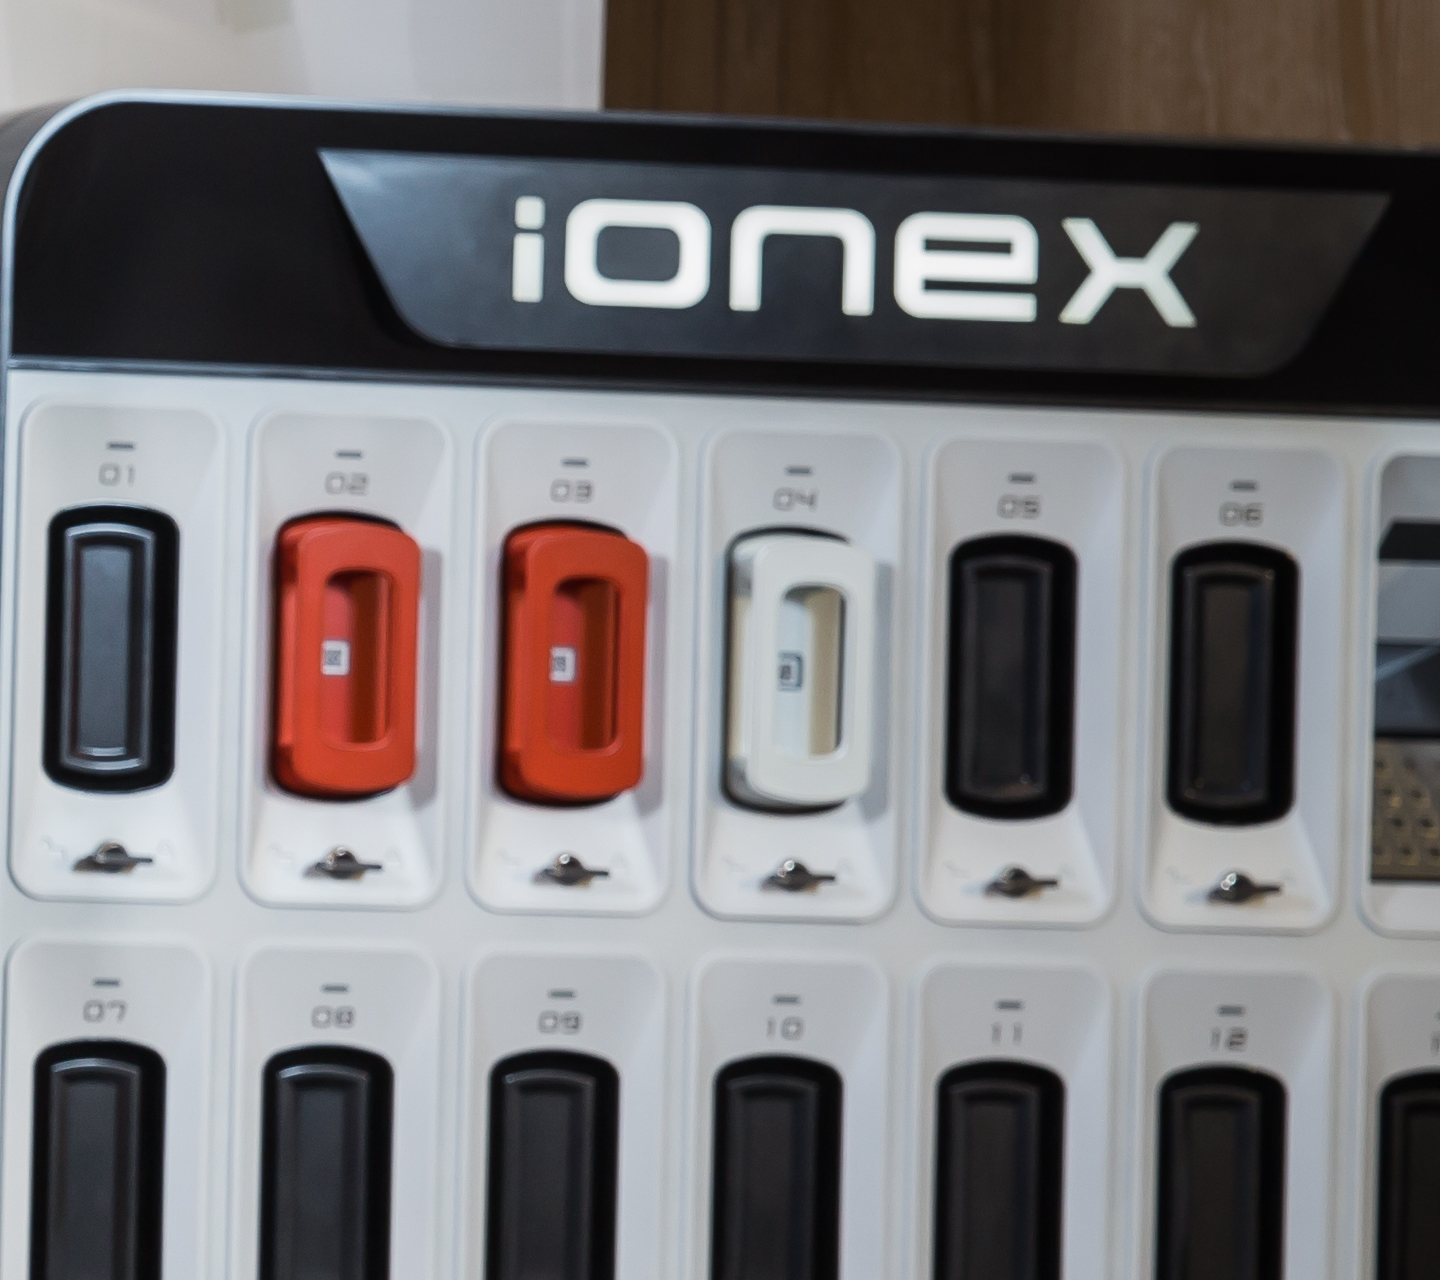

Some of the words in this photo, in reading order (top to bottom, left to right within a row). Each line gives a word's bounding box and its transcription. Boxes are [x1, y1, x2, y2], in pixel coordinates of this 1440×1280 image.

[511, 195, 1198, 328] ionex
[98, 461, 136, 488] 01
[325, 471, 370, 497] 02
[772, 487, 819, 512] 04
[997, 495, 1042, 520] 05
[1219, 502, 1265, 527] 06
[82, 998, 128, 1024] 07
[766, 1016, 805, 1042] 10
[991, 1021, 1024, 1046] 11
[1211, 1026, 1248, 1052] 12
